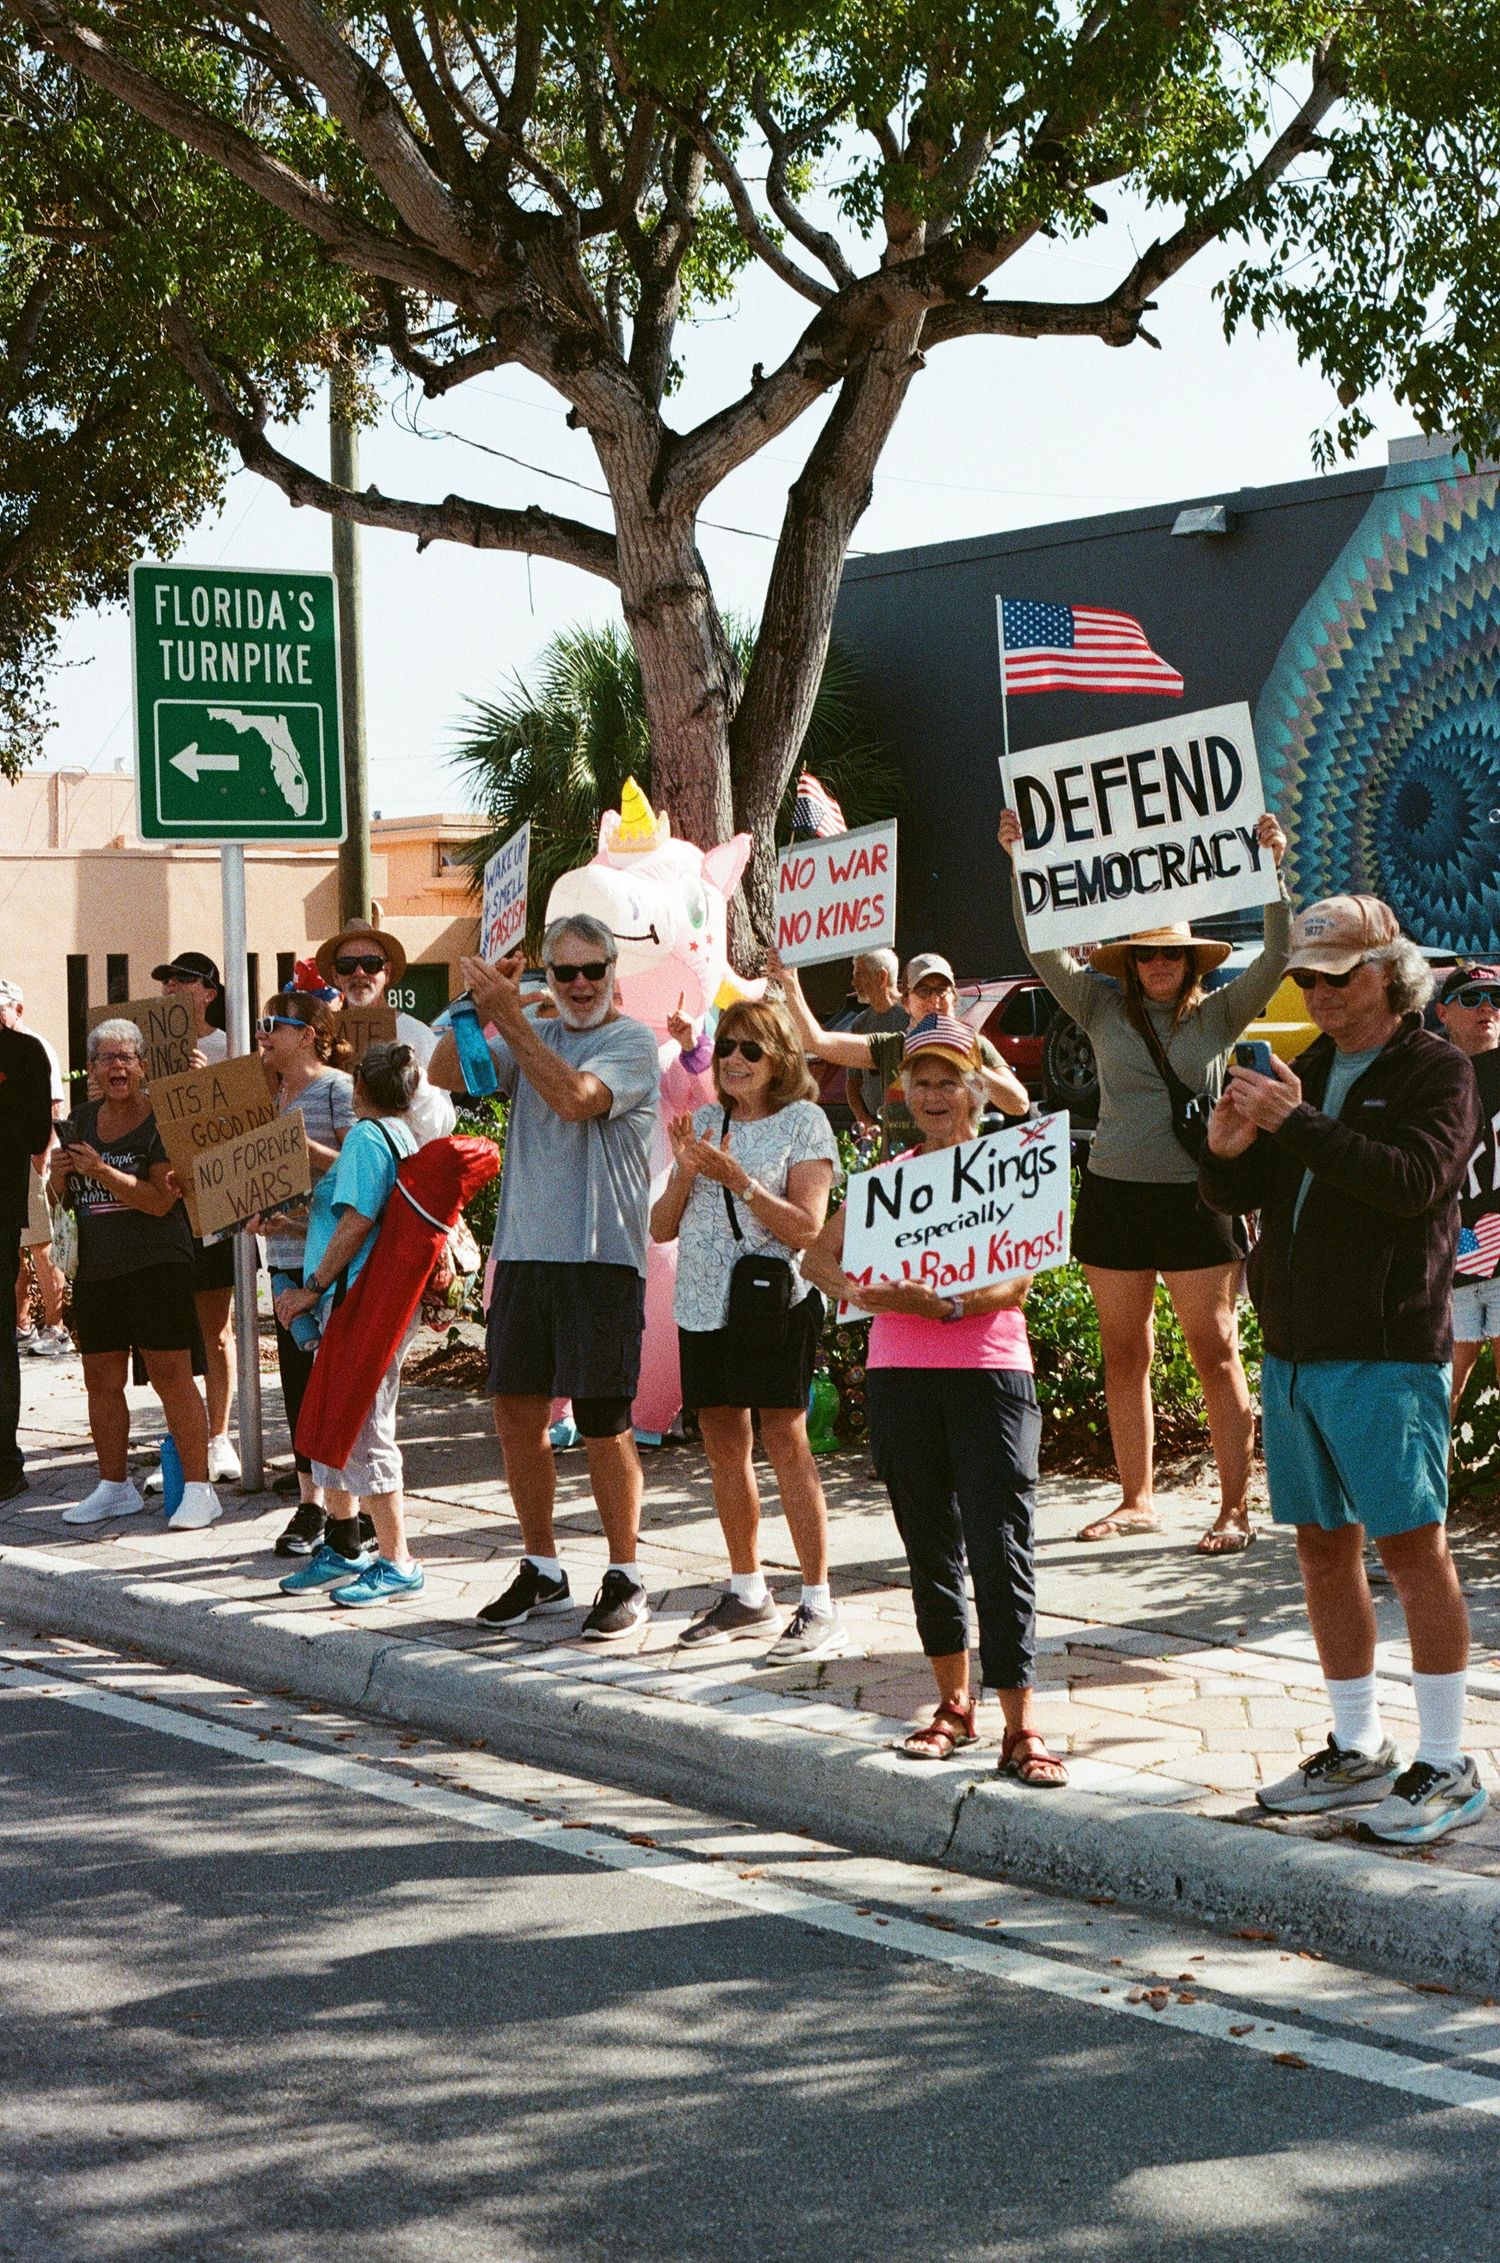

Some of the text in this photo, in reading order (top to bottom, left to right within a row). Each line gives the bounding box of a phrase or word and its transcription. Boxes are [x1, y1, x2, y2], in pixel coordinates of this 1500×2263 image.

[155, 585, 315, 631] FLORIDA'S
[159, 639, 312, 684] TURNPIKE
[1013, 735, 1243, 851] DEFEND
[486, 832, 527, 891] WAKE UP
[779, 843, 889, 894] NO WAR
[1018, 824, 1262, 916] DEMOCRACY
[492, 870, 524, 918] SMELL
[489, 898, 527, 958] FASCISM
[778, 894, 885, 950] NO KINGS
[149, 1004, 188, 1042] NO
[388, 989, 415, 1008] 813
[166, 1077, 229, 1119] ITS A
[191, 1103, 275, 1148] GOOD DAY
[199, 1125, 303, 1190] NO FOREVER
[226, 1165, 292, 1219] WARS
[865, 1140, 1057, 1228] No Kings
[895, 1200, 1014, 1248] especially
[920, 1246, 976, 1289] Bad
[987, 1209, 1064, 1275] Kings!
